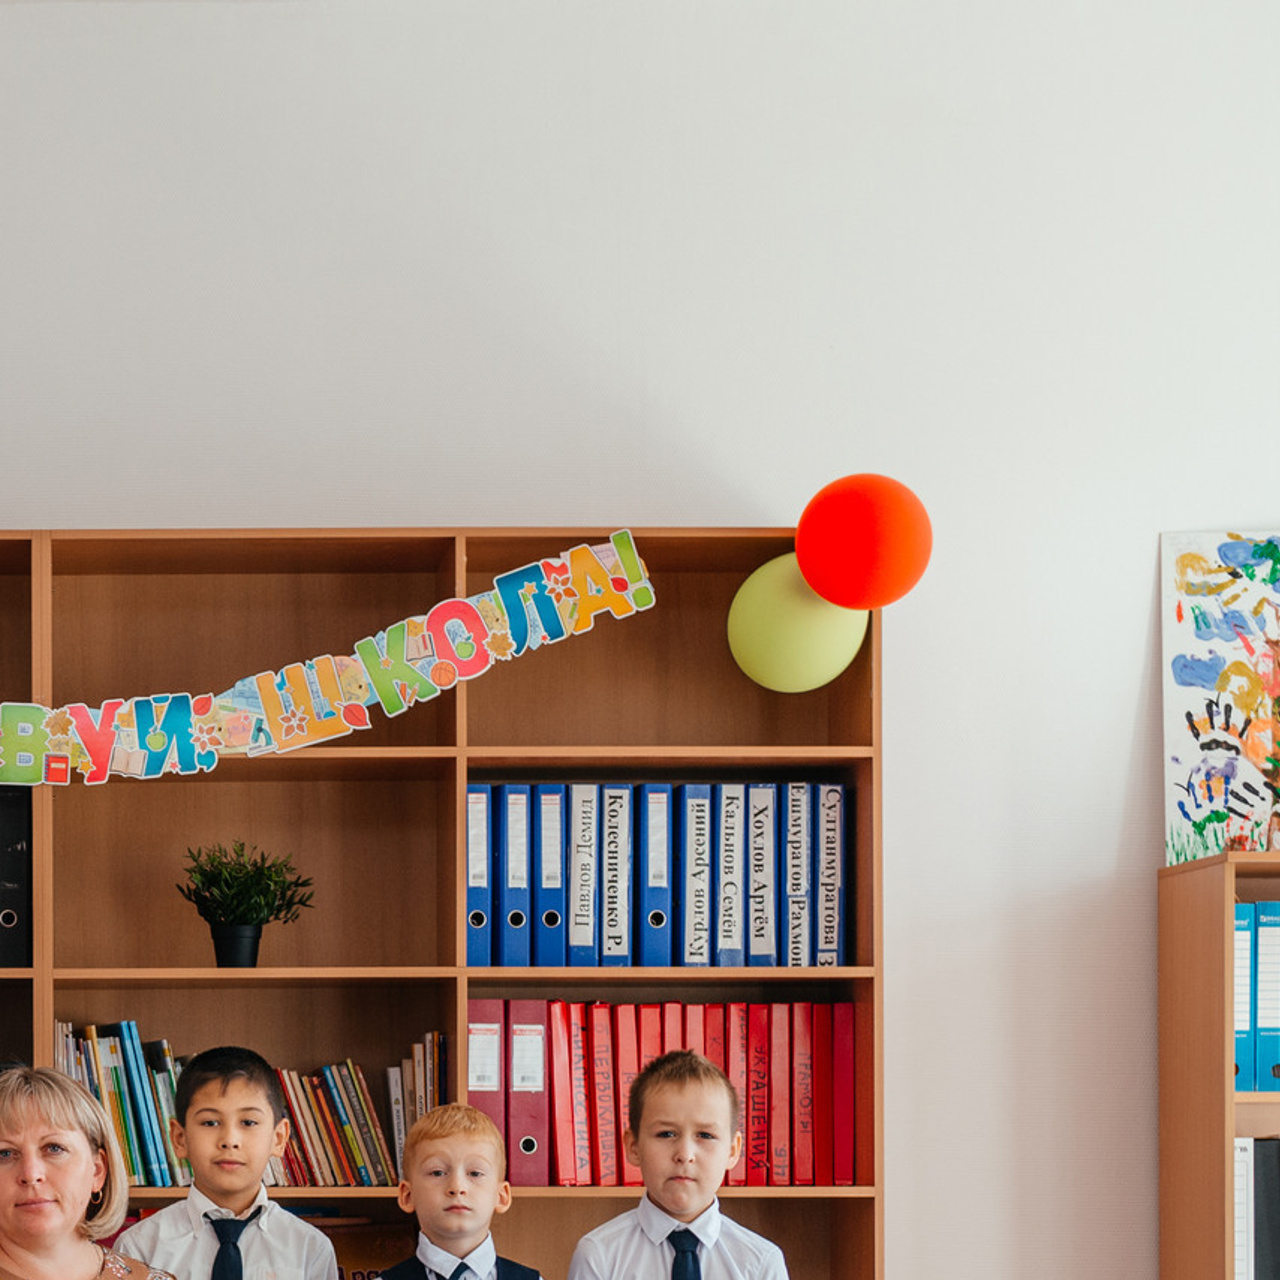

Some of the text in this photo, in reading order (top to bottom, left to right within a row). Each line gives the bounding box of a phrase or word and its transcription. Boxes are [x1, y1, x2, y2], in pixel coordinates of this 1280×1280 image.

[254, 529, 656, 756] ШКОЛА!
[574, 798, 594, 927] Павлов Демид
[607, 794, 624, 952] Колесниченко Р.
[689, 802, 709, 958] Курлов Арсений
[719, 795, 739, 940] Кальнов Семён
[750, 805, 769, 939] Хохлов Артём
[787, 782, 806, 893] Ешмуратов
[821, 788, 841, 946] Султанмуратова
[572, 1021, 590, 1170] ДИАГНОСТИКА
[593, 1044, 616, 1180] ПЕРВОКЛАШКИ
[797, 1051, 813, 1134] ГРАМОТЫ
